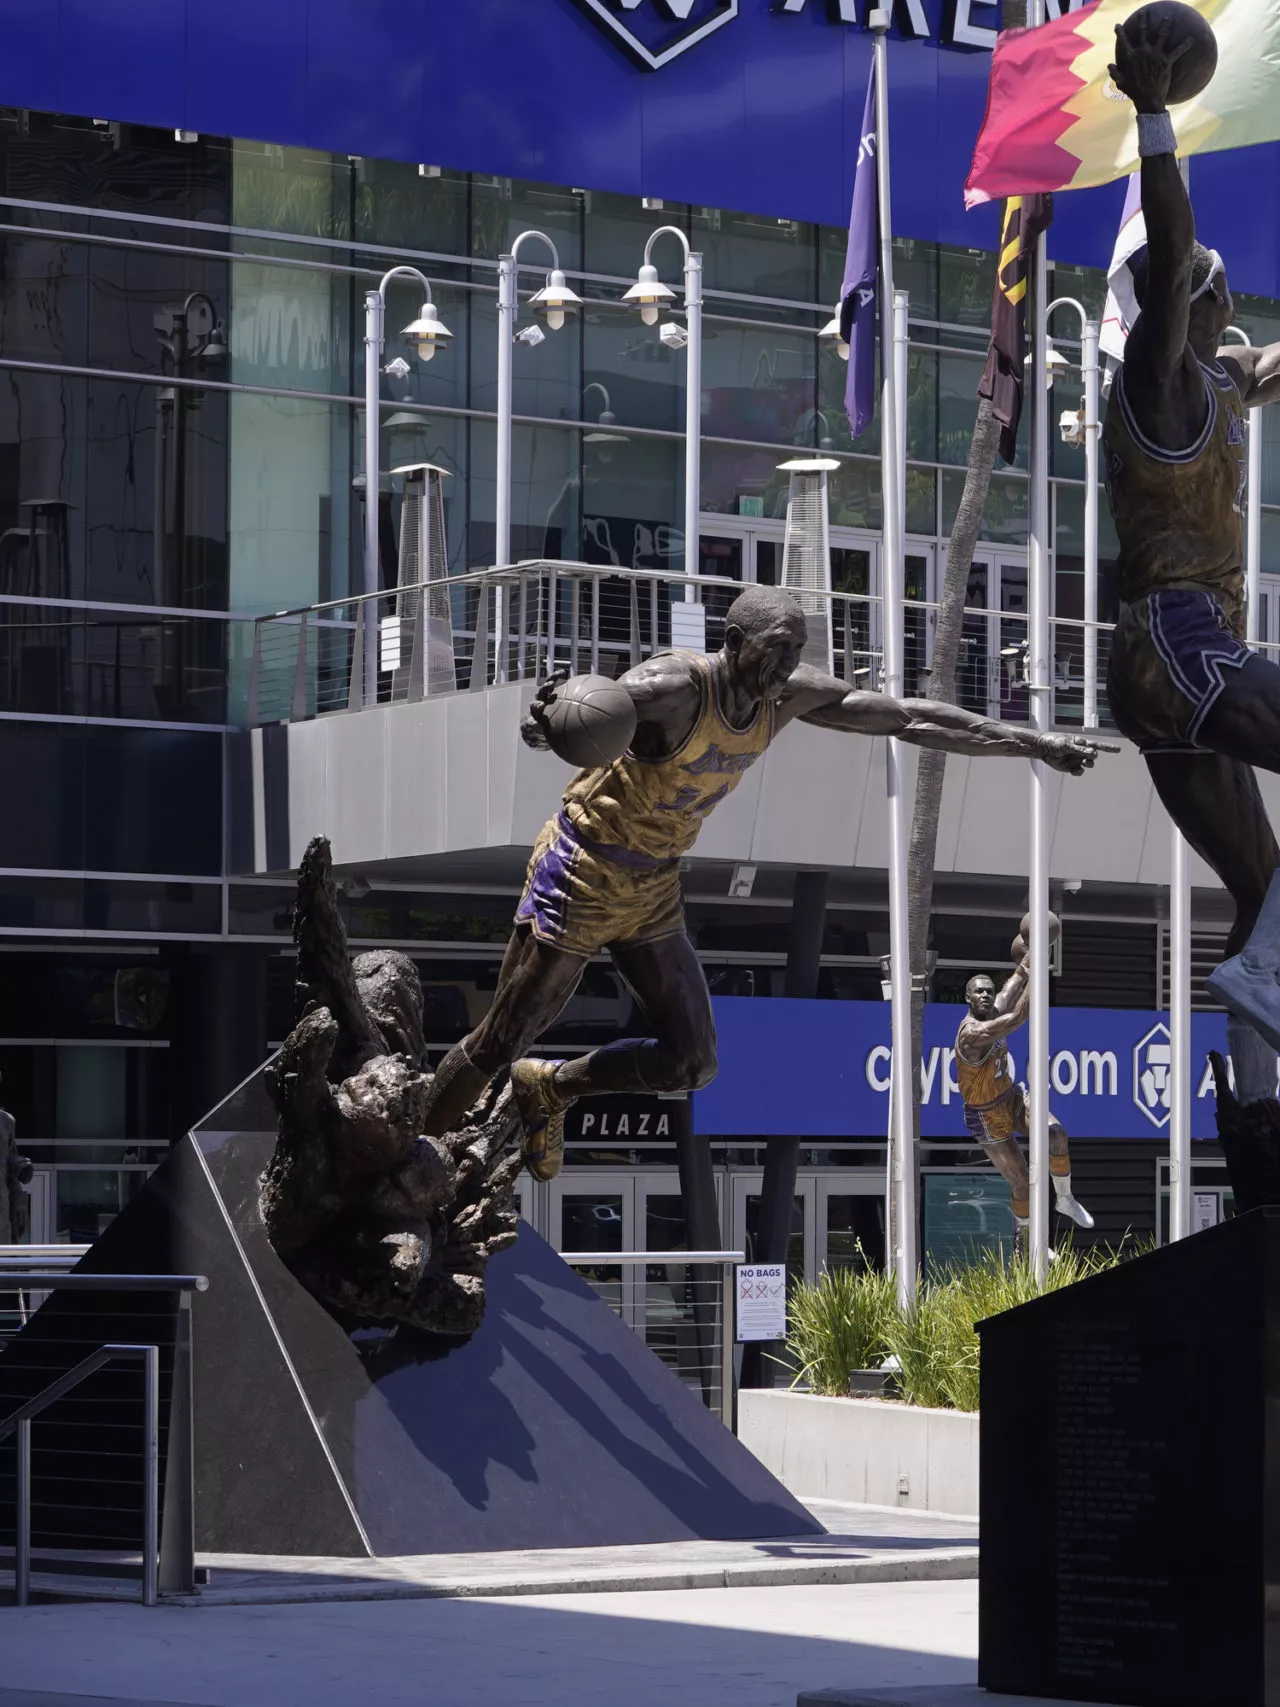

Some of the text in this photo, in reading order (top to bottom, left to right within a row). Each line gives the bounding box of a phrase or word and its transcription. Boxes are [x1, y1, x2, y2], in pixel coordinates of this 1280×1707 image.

[581, 1113, 670, 1136] PLAZA
[740, 1268, 781, 1278] NO BAGS
